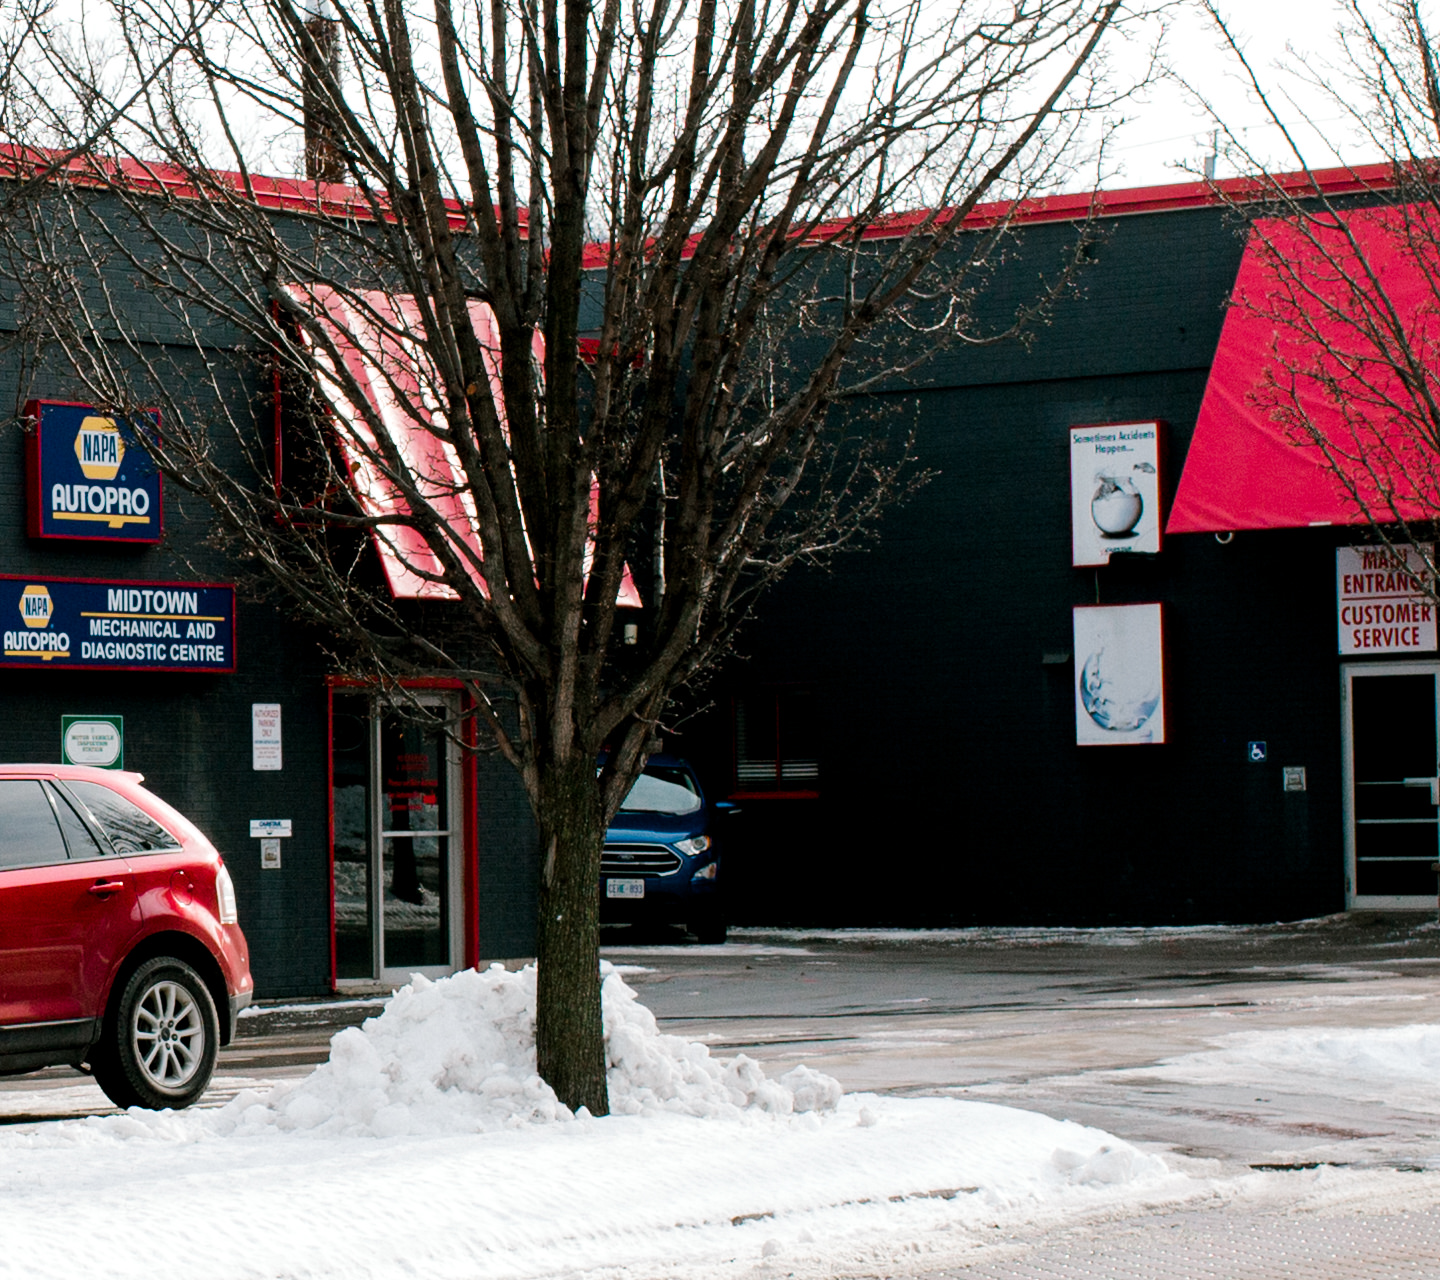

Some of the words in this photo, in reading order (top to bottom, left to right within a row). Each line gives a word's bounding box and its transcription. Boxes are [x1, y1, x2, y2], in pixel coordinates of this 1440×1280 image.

[1073, 433, 1116, 444] Sometimes
[1119, 429, 1155, 439] Accidents
[83, 433, 117, 463] NAPA
[51, 483, 150, 515] AUTOPRO
[1362, 548, 1407, 570] MAIN
[25, 596, 48, 616] NAPA
[107, 589, 198, 614] MIDTOWN
[1341, 603, 1431, 625] CUSTOMER
[89, 619, 181, 638] MECHANICAL
[186, 622, 216, 640] AND
[1353, 627, 1420, 648] SERVICE
[3, 631, 70, 651] AUTOPRO
[81, 641, 167, 660] DIAGNOSTIC
[169, 644, 225, 662] CENTRE
